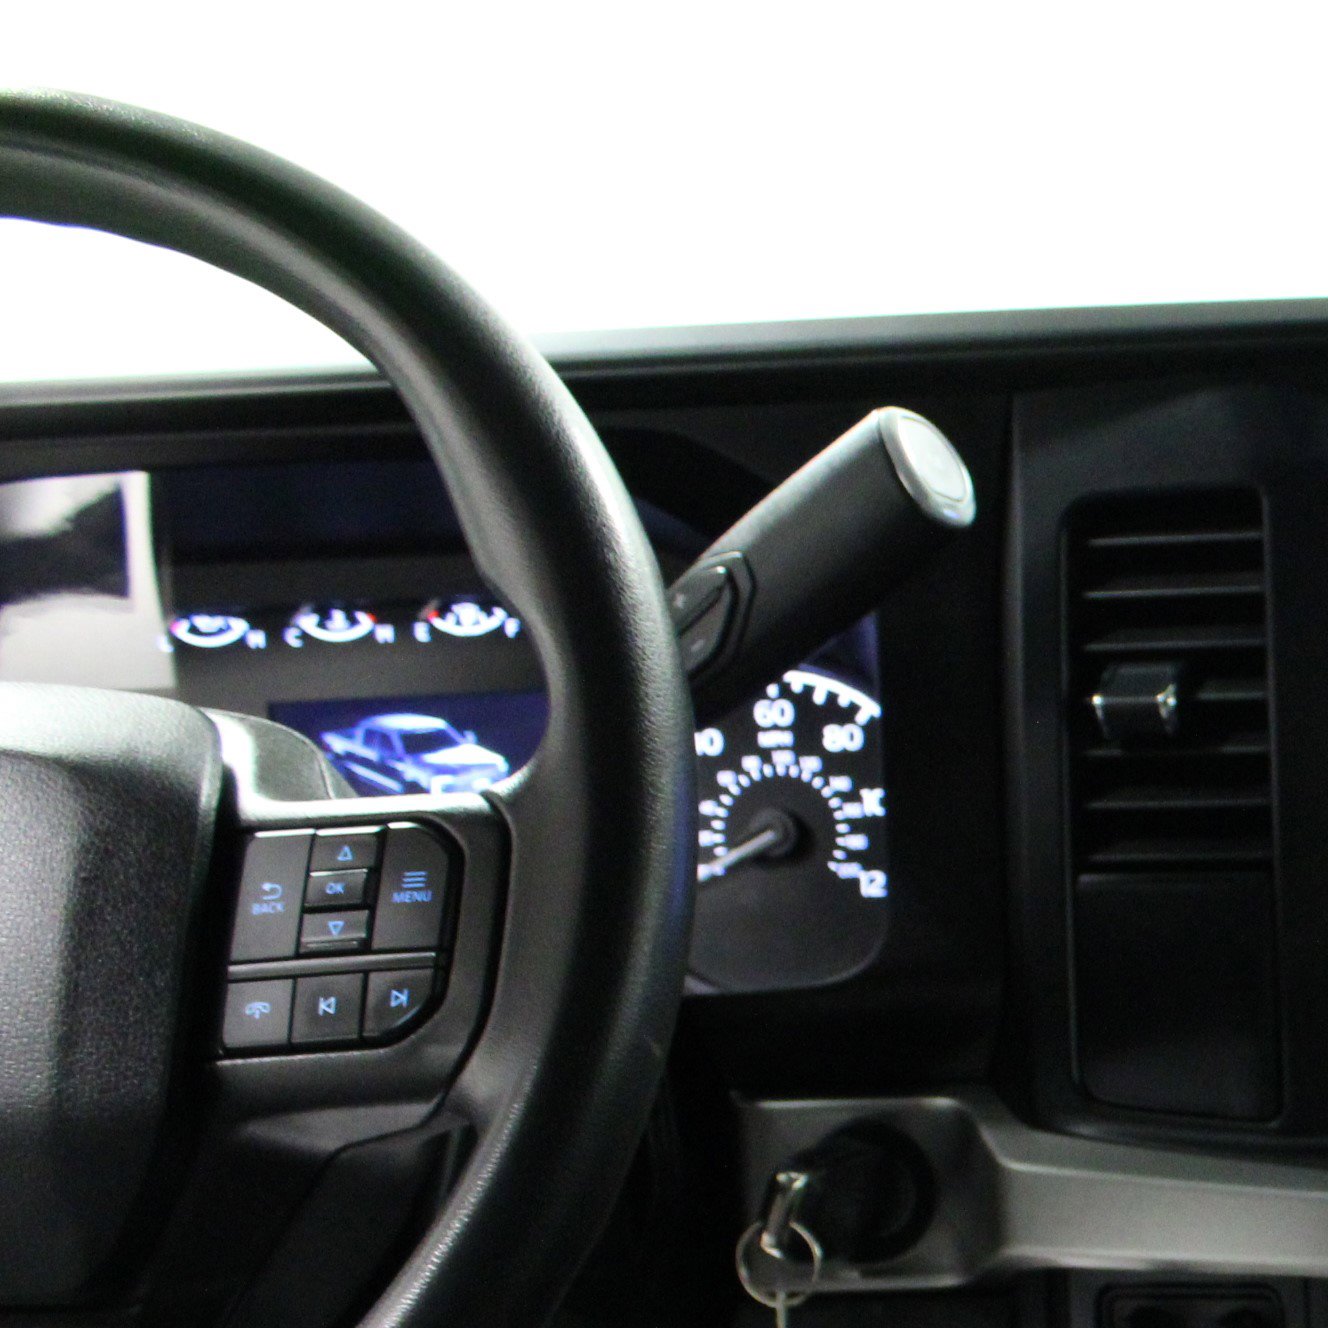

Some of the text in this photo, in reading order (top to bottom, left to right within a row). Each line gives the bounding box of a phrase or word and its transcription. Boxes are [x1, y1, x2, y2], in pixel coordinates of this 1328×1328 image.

[753, 699, 795, 728] 60
[822, 724, 865, 752] 80
[325, 882, 345, 895] OK
[392, 890, 433, 904] MENU
[252, 902, 286, 916] BACK
